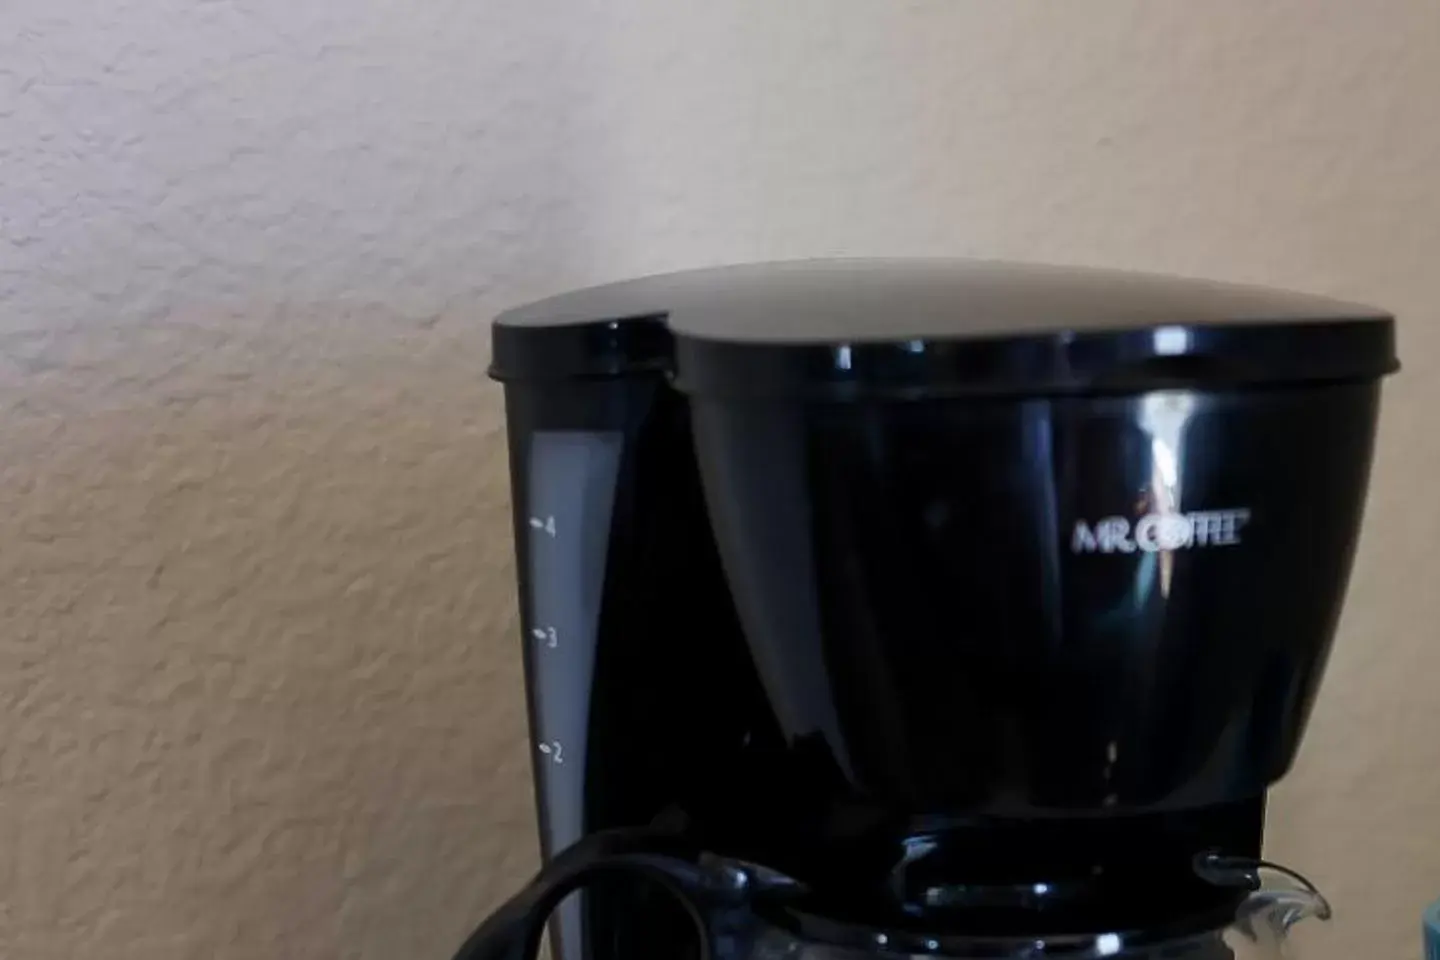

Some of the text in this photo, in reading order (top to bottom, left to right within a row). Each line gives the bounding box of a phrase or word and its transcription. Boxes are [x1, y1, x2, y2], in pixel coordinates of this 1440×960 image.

[545, 516, 556, 537] 4
[548, 626, 558, 648] 3
[553, 741, 563, 764] 2
